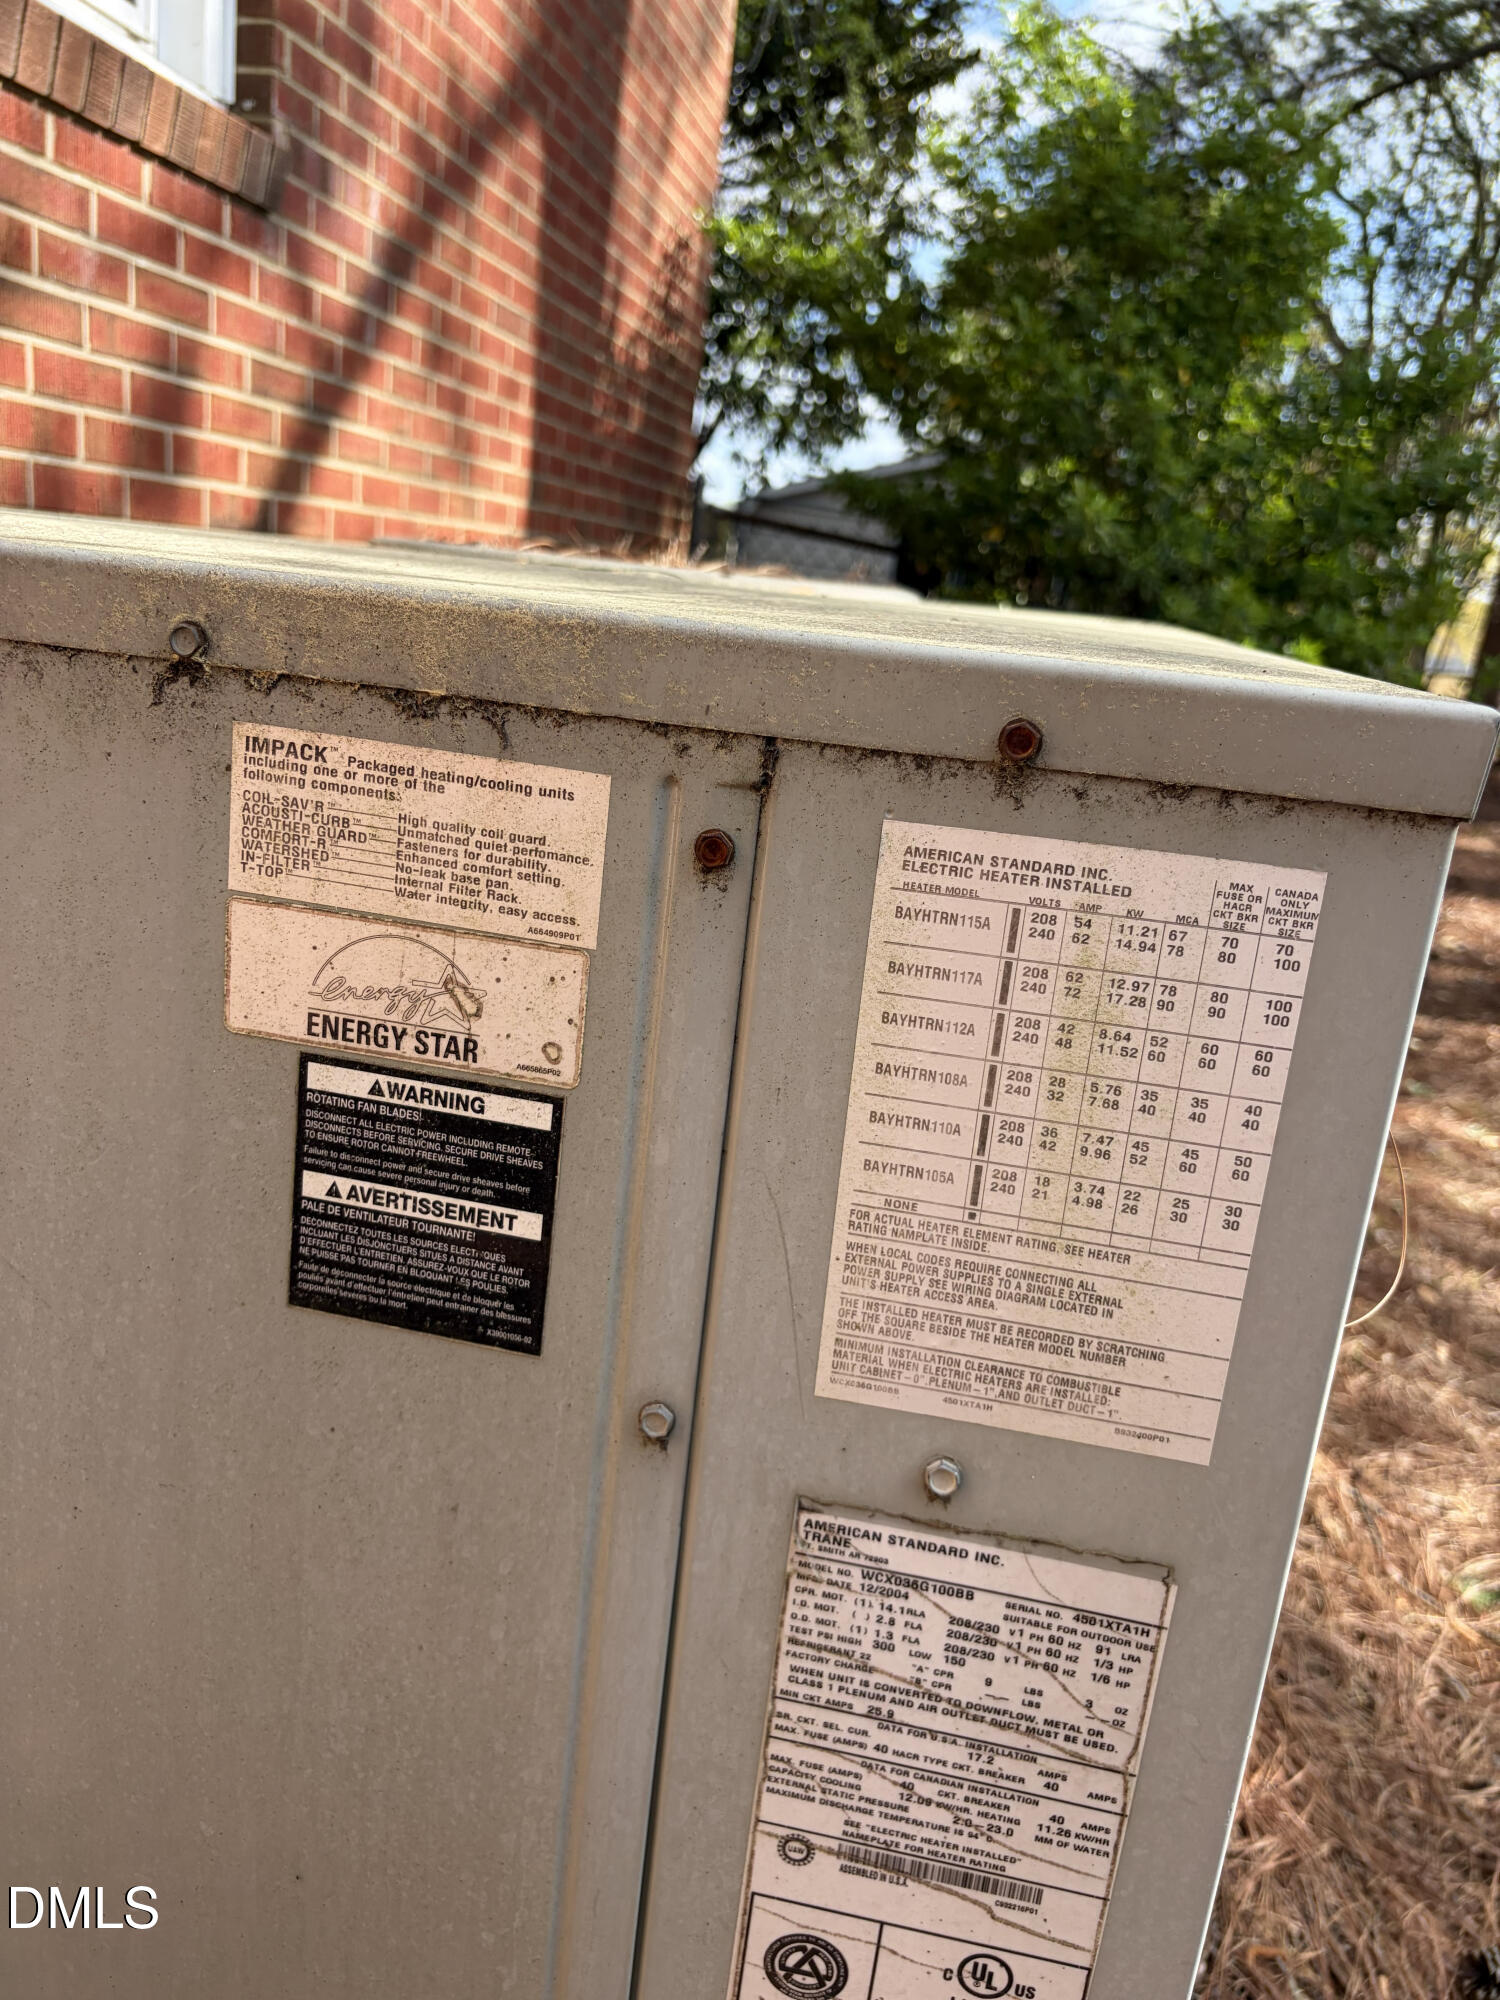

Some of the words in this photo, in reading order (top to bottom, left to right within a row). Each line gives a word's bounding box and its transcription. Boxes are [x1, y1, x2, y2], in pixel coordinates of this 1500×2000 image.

[243, 753, 307, 776] including
[313, 765, 337, 778] one
[343, 769, 357, 781] or
[363, 772, 398, 787] more
[404, 777, 417, 790] of
[423, 780, 445, 794] the
[243, 767, 305, 788] following
[347, 755, 414, 778] Packaged
[421, 766, 532, 796] heating/cooling
[538, 784, 575, 801] units
[397, 813, 425, 829] High
[432, 818, 475, 837] quality
[481, 826, 504, 840] coil
[509, 830, 551, 849] guard.
[397, 825, 469, 847] Unmatched
[474, 838, 507, 854] quiet
[242, 813, 310, 835] WEATHER
[396, 837, 458, 858] Fasteners
[464, 848, 483, 862] for
[485, 852, 552, 874] durability.
[395, 849, 457, 870] Enhanced
[463, 860, 512, 879] comfort
[517, 869, 565, 889] setting.
[903, 845, 983, 866] AMERICAN
[989, 855, 1075, 877] STANDARD
[1081, 865, 1113, 881] INC.
[395, 862, 445, 881] No-leak
[451, 871, 480, 886] base
[485, 878, 513, 893] pan.
[902, 859, 974, 879] ELECTRIC
[979, 868, 1040, 887] HEATER
[1045, 876, 1132, 898] INSTALLED
[1229, 882, 1253, 893] MAX
[394, 874, 442, 892] Internal
[486, 889, 522, 905] Rack.
[902, 880, 941, 893] HEATER
[945, 886, 980, 898] MODEL
[1216, 891, 1245, 902] FUSE
[1247, 894, 1262, 904] OR
[1274, 888, 1319, 901] CANADA
[394, 886, 430, 902] Water
[435, 892, 493, 915] integrity,
[498, 904, 527, 920] easy
[532, 909, 580, 927] access.
[1028, 896, 1061, 908] VOLTS
[1078, 902, 1102, 913] AMP
[1223, 901, 1252, 912] HACR
[1280, 898, 1309, 910] ONLY
[894, 905, 991, 930] BAYHTRN115A
[1030, 912, 1057, 926] 208
[1073, 916, 1092, 929] 54
[1126, 908, 1144, 918] KW
[1175, 914, 1199, 925] MCA
[1212, 910, 1232, 920] CKT
[1236, 913, 1258, 923] BKR
[1264, 906, 1319, 920] MAXIMUM
[1028, 926, 1055, 940] 240
[1117, 923, 1158, 938] 11.21
[1222, 920, 1245, 930] SIZE
[1267, 917, 1288, 927] CKT
[1291, 919, 1313, 930] BKR
[1277, 927, 1301, 937] SIZE
[1070, 932, 1090, 945] 62
[1115, 938, 1157, 953] 14.94
[1167, 929, 1188, 942] 67
[1221, 936, 1239, 949] 70
[1166, 944, 1185, 957] 78
[1217, 951, 1236, 964] 80
[1275, 943, 1294, 956] 70
[887, 960, 983, 985] BAYHTRN117A
[1273, 958, 1300, 972] 100
[881, 1010, 976, 1037] BAYHTRN112A
[307, 1012, 407, 1051] ENERGY
[414, 1029, 478, 1063] STAR
[874, 1061, 969, 1088] BAYHTRN108A
[306, 1091, 355, 1110] ROTATING
[357, 1101, 376, 1114] FAN
[385, 1080, 486, 1116] WARNING
[305, 1107, 356, 1125] DISCONNECT
[359, 1117, 374, 1128] ALL
[375, 1120, 415, 1136] ELECTRIC
[417, 1128, 447, 1142] POWER
[448, 1134, 494, 1151] INCLUDING
[868, 1110, 962, 1137] BAYHTRN110A
[305, 1128, 315, 1138] TO
[317, 1131, 349, 1144] ENSURE
[351, 1137, 379, 1150] ROTOR
[381, 1143, 414, 1157] CANNOT
[305, 1117, 361, 1136] DISCONNECTS
[363, 1128, 395, 1143] BEFORE
[444, 1144, 478, 1158] SECURE
[480, 1150, 504, 1163] DRIVE
[506, 1155, 543, 1170] SHEAVES
[862, 1158, 955, 1185] BAYHTRN105A
[346, 1183, 518, 1232] AVERTISSEMENT
[883, 1197, 918, 1212] NONE
[301, 1199, 324, 1213] PALE
[327, 1204, 340, 1216] DE
[343, 1207, 409, 1229] VENTILATEUR
[411, 1220, 476, 1242] TOURNANTE!
[848, 1220, 887, 1236] RATING
[891, 1226, 947, 1246] NAMPLATE
[951, 1236, 991, 1253] INSIDE.
[849, 1208, 870, 1221] FOR
[874, 1212, 913, 1228] ACTUAL
[917, 1219, 959, 1235] HEATER
[963, 1227, 1012, 1244] ELEMENT
[1063, 1244, 1084, 1256] SEE
[1087, 1247, 1131, 1264] HEATER
[802, 1529, 851, 1548] TRANE
[804, 1518, 882, 1542] AMERICAN
[887, 1534, 969, 1559] STANDARD
[973, 1550, 1005, 1566] INC.
[836, 1568, 854, 1577] NO.
[860, 1569, 974, 1601] WCX036G100BB
[859, 1582, 909, 1600] 12/2004
[1004, 1601, 1042, 1615] SERIAL
[1045, 1609, 1063, 1620] NO.
[843, 1819, 861, 1829] SEE
[920, 1836, 959, 1851] HEATER
[841, 1829, 900, 1849] NAMEPLATE
[904, 1843, 924, 1854] FOR
[927, 1848, 966, 1863] HEATER
[969, 1858, 1006, 1872] RATING
[1015, 1983, 1036, 1999] US
